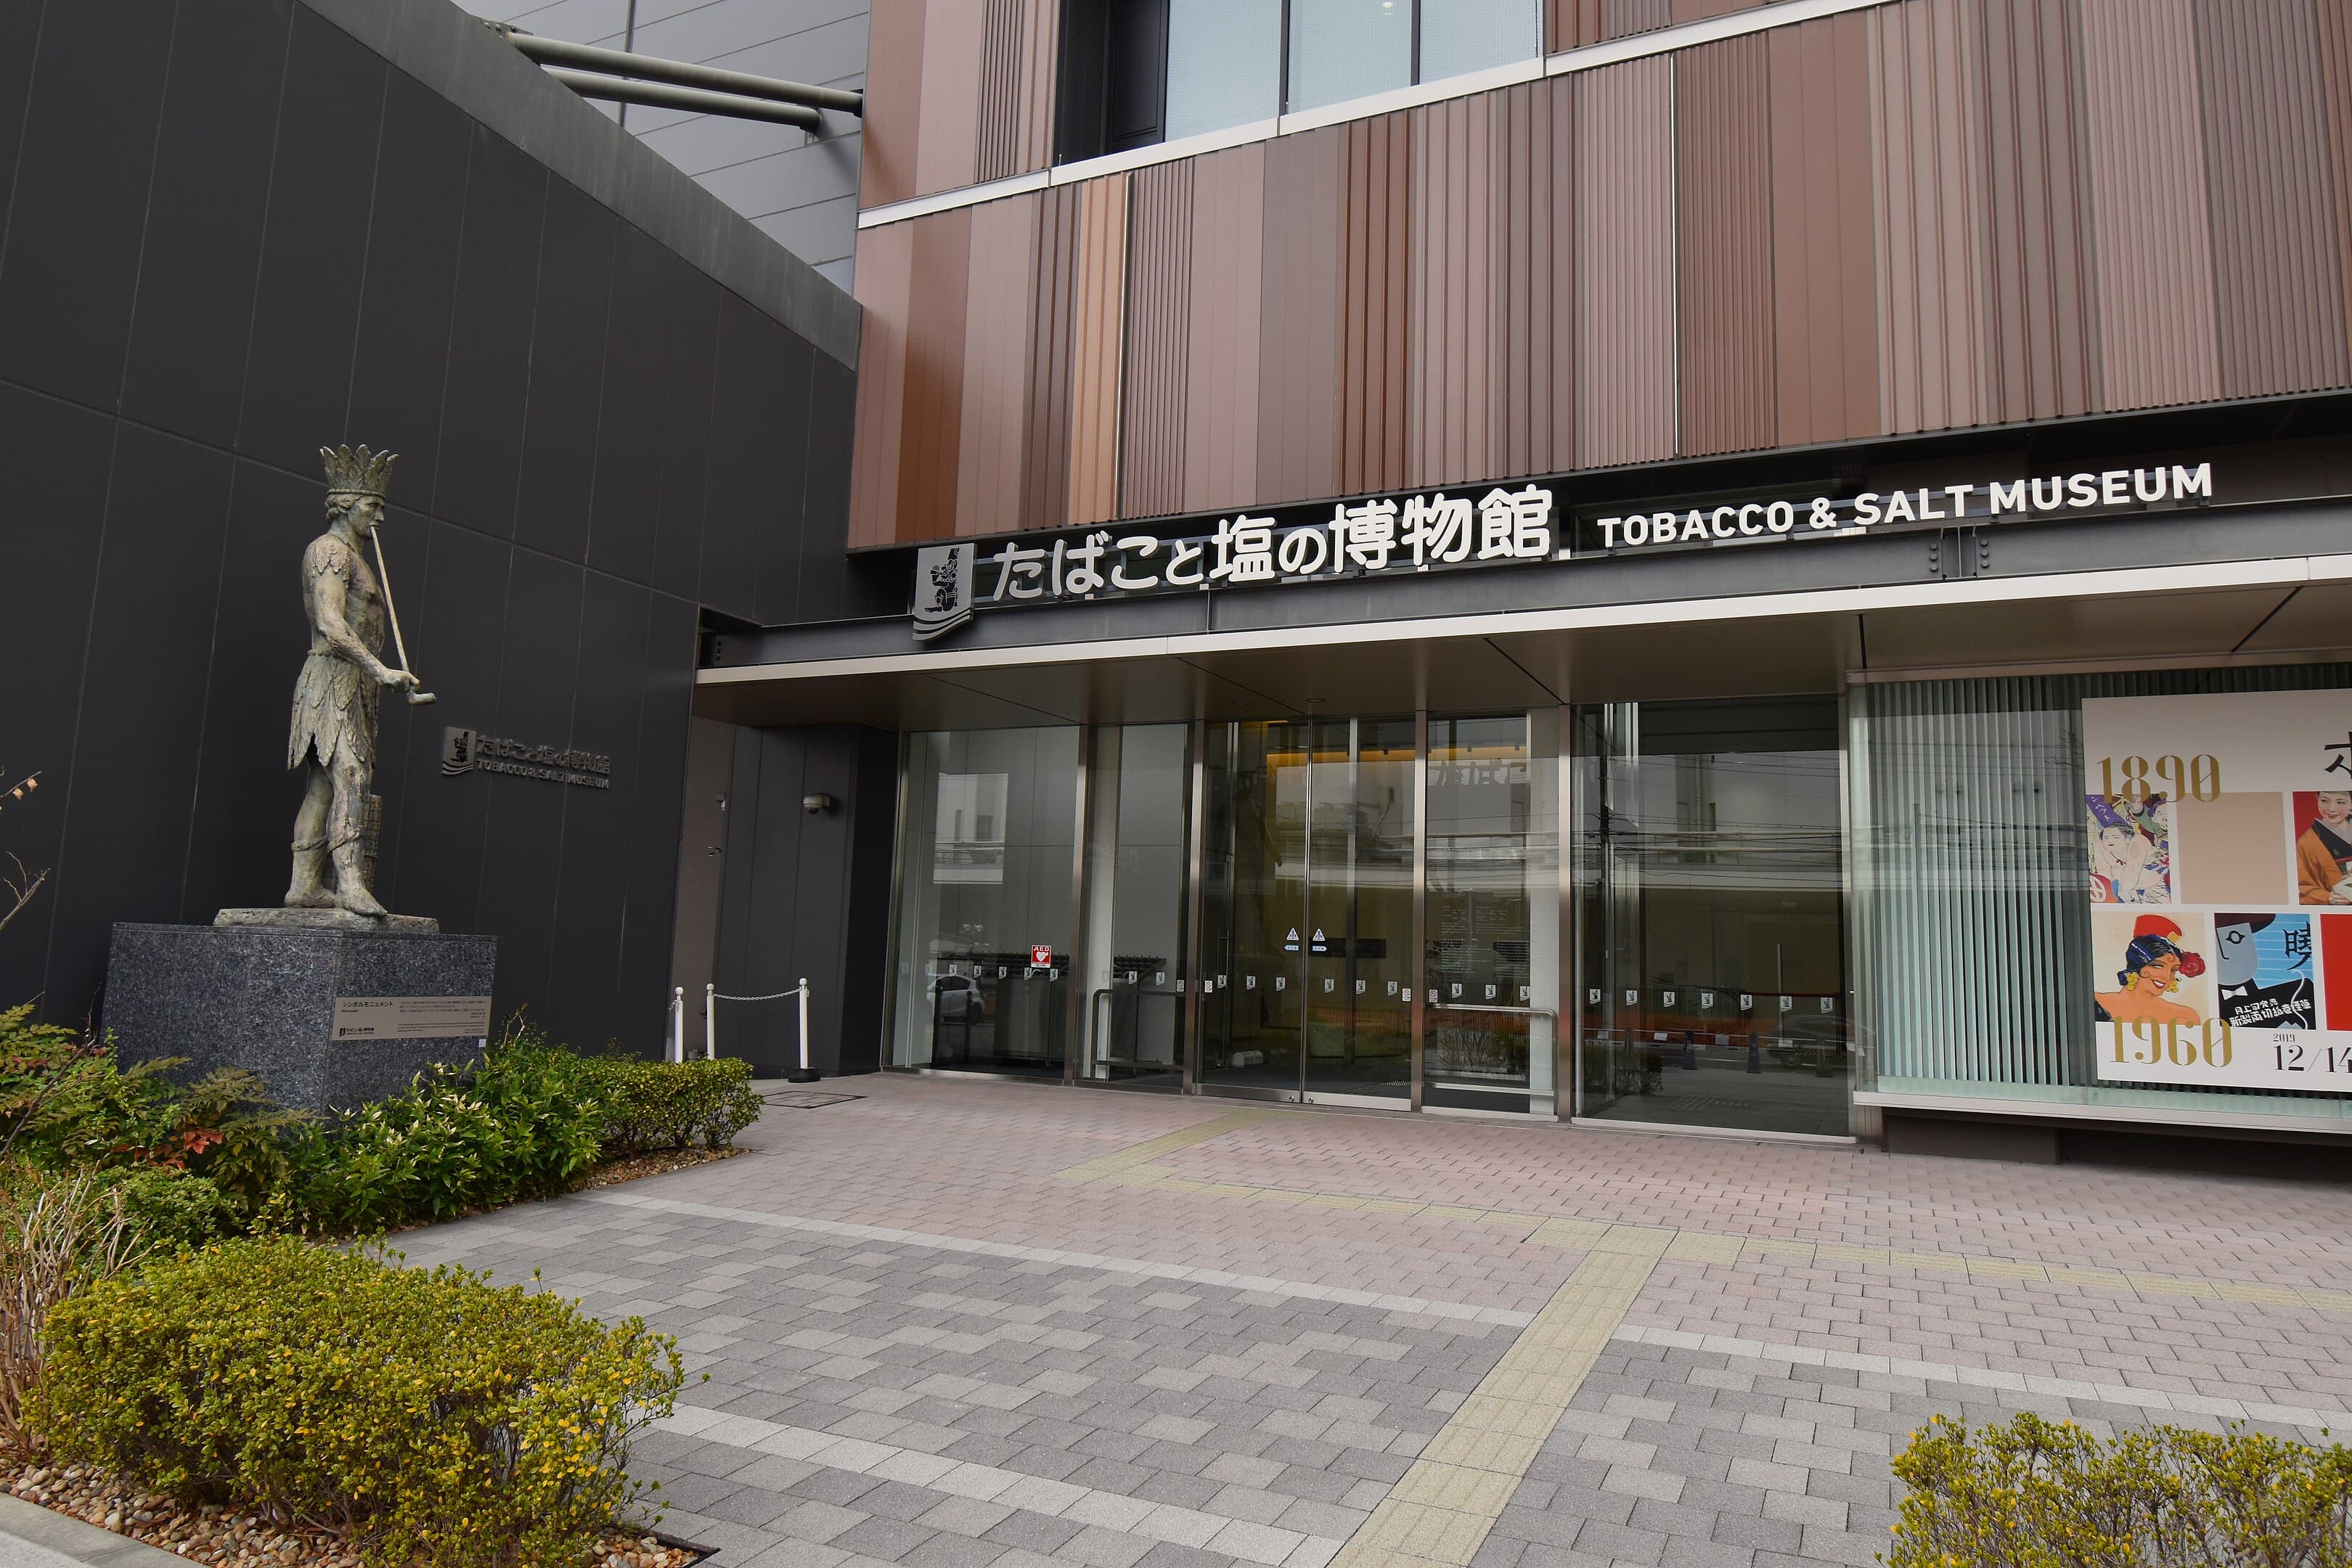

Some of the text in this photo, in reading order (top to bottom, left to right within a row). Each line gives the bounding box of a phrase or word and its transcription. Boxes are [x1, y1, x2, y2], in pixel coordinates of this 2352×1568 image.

[1598, 462, 2212, 547] TOBACCO & SALT MUSEUM
[993, 483, 1553, 602] たばこと塩の博物館
[476, 735, 610, 775] たばこと塩の博物館
[477, 759, 527, 775] TOBACCO
[538, 769, 565, 783] SALT
[567, 772, 610, 789] MUSEUM
[2097, 754, 2220, 803] 1890
[2110, 1015, 2232, 1068] 1960
[2273, 1033, 2295, 1042] 2019
